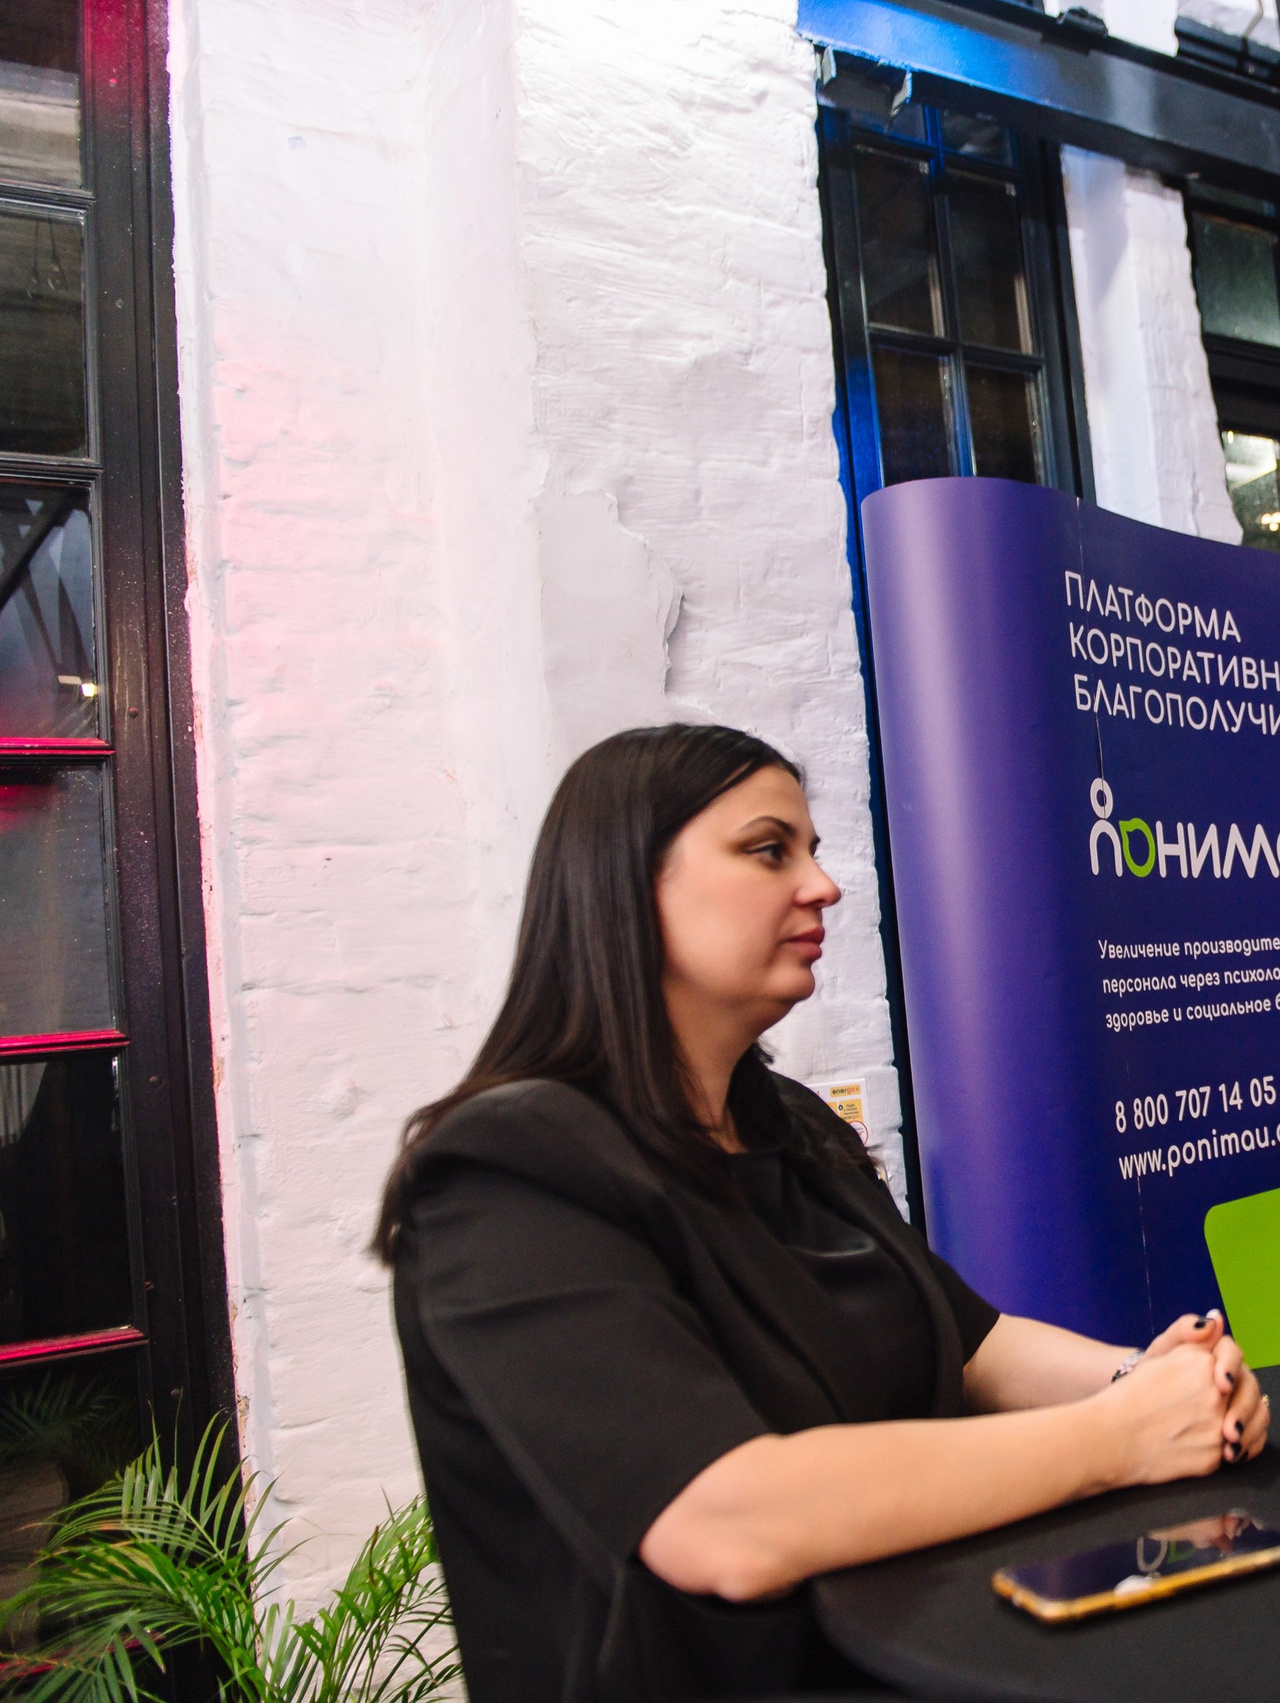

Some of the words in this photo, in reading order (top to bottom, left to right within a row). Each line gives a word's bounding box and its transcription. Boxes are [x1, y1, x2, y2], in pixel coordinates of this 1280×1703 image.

[1065, 570, 1241, 643] ПЛАТФОРМА
[1098, 939, 1180, 959] Увеличение
[1102, 976, 1177, 997] персонала
[1180, 971, 1220, 991] через
[1106, 1009, 1169, 1032] здоровье
[1173, 1008, 1182, 1021] и
[1186, 997, 1271, 1020] социальное
[1115, 1100, 1127, 1133] 8
[1133, 1093, 1169, 1130] 800
[1175, 1086, 1211, 1122] 707
[1219, 1081, 1243, 1113] 14
[1250, 1075, 1277, 1107] 05
